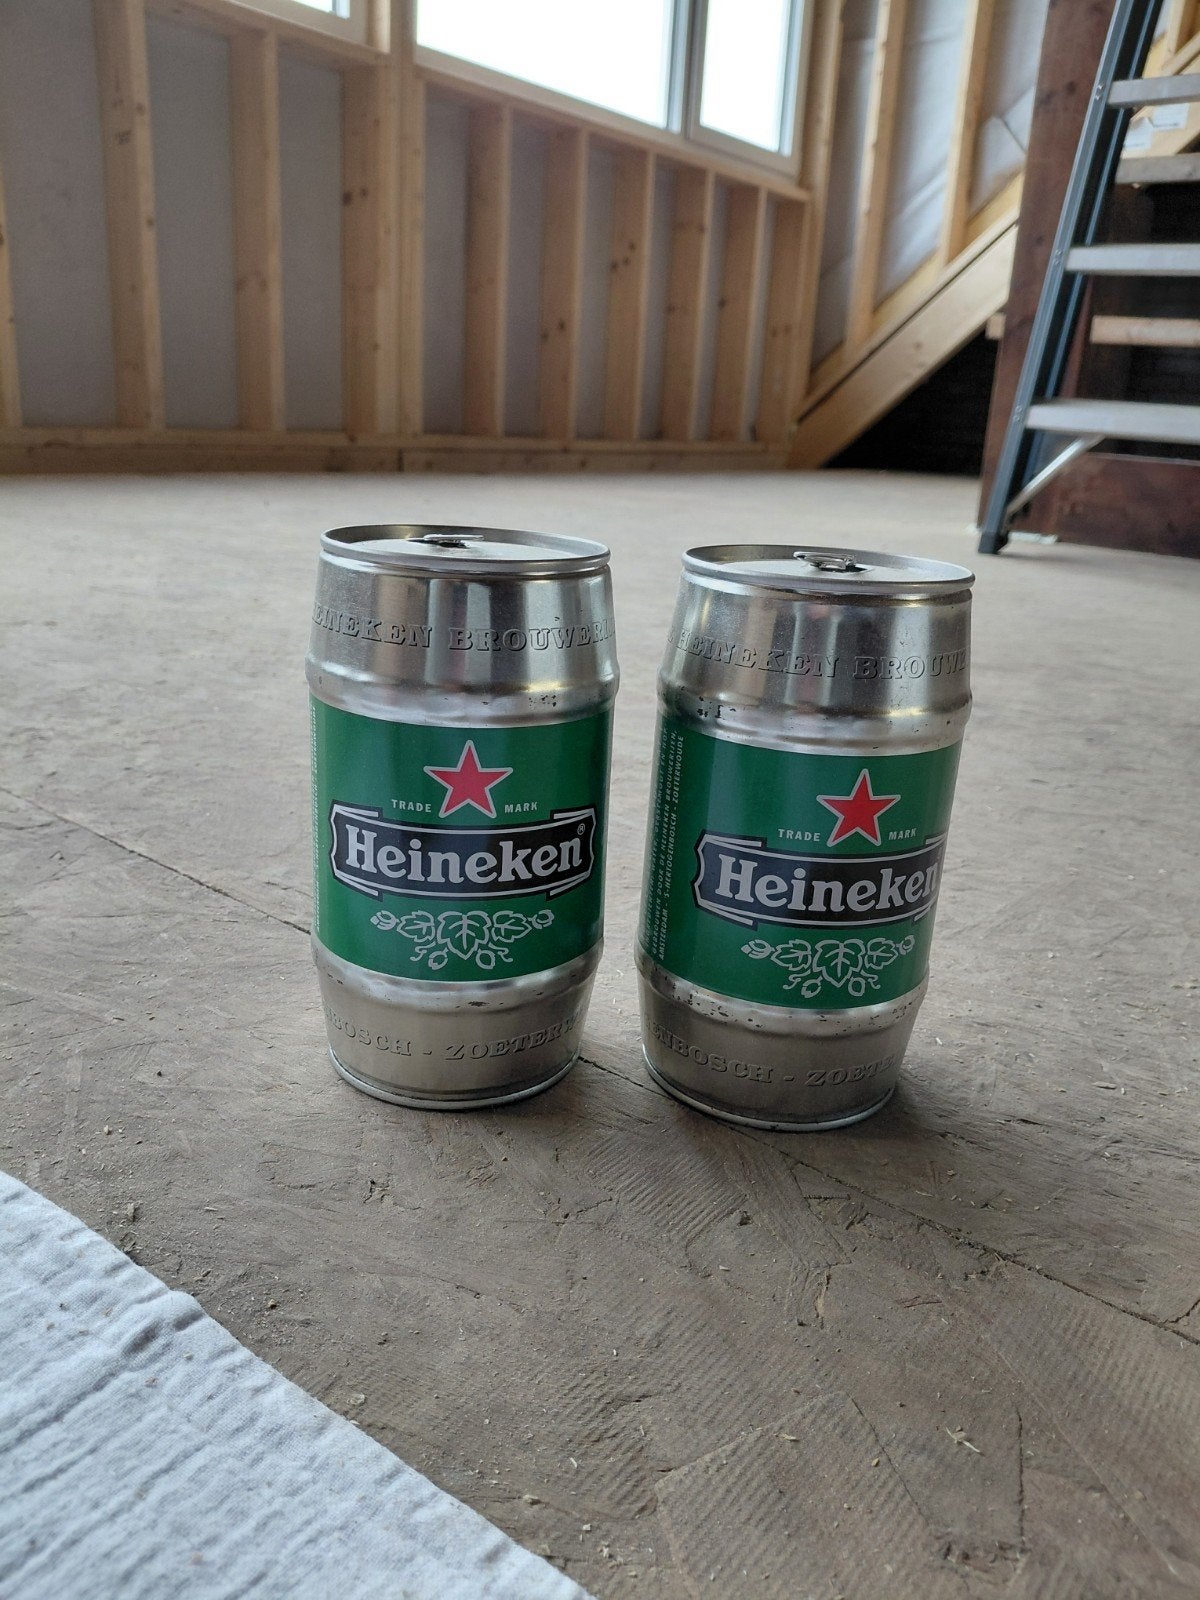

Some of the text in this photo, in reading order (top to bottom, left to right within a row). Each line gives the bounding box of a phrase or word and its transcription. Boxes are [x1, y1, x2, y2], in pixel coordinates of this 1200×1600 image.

[391, 799, 538, 814] TRADE MARK
[778, 827, 917, 842] TRADE MARK
[345, 823, 583, 884] Heineken
[659, 908, 668, 961] AMSTERDAM
[672, 736, 684, 804] ZOETERWOUDE
[714, 853, 938, 912] Heineken
